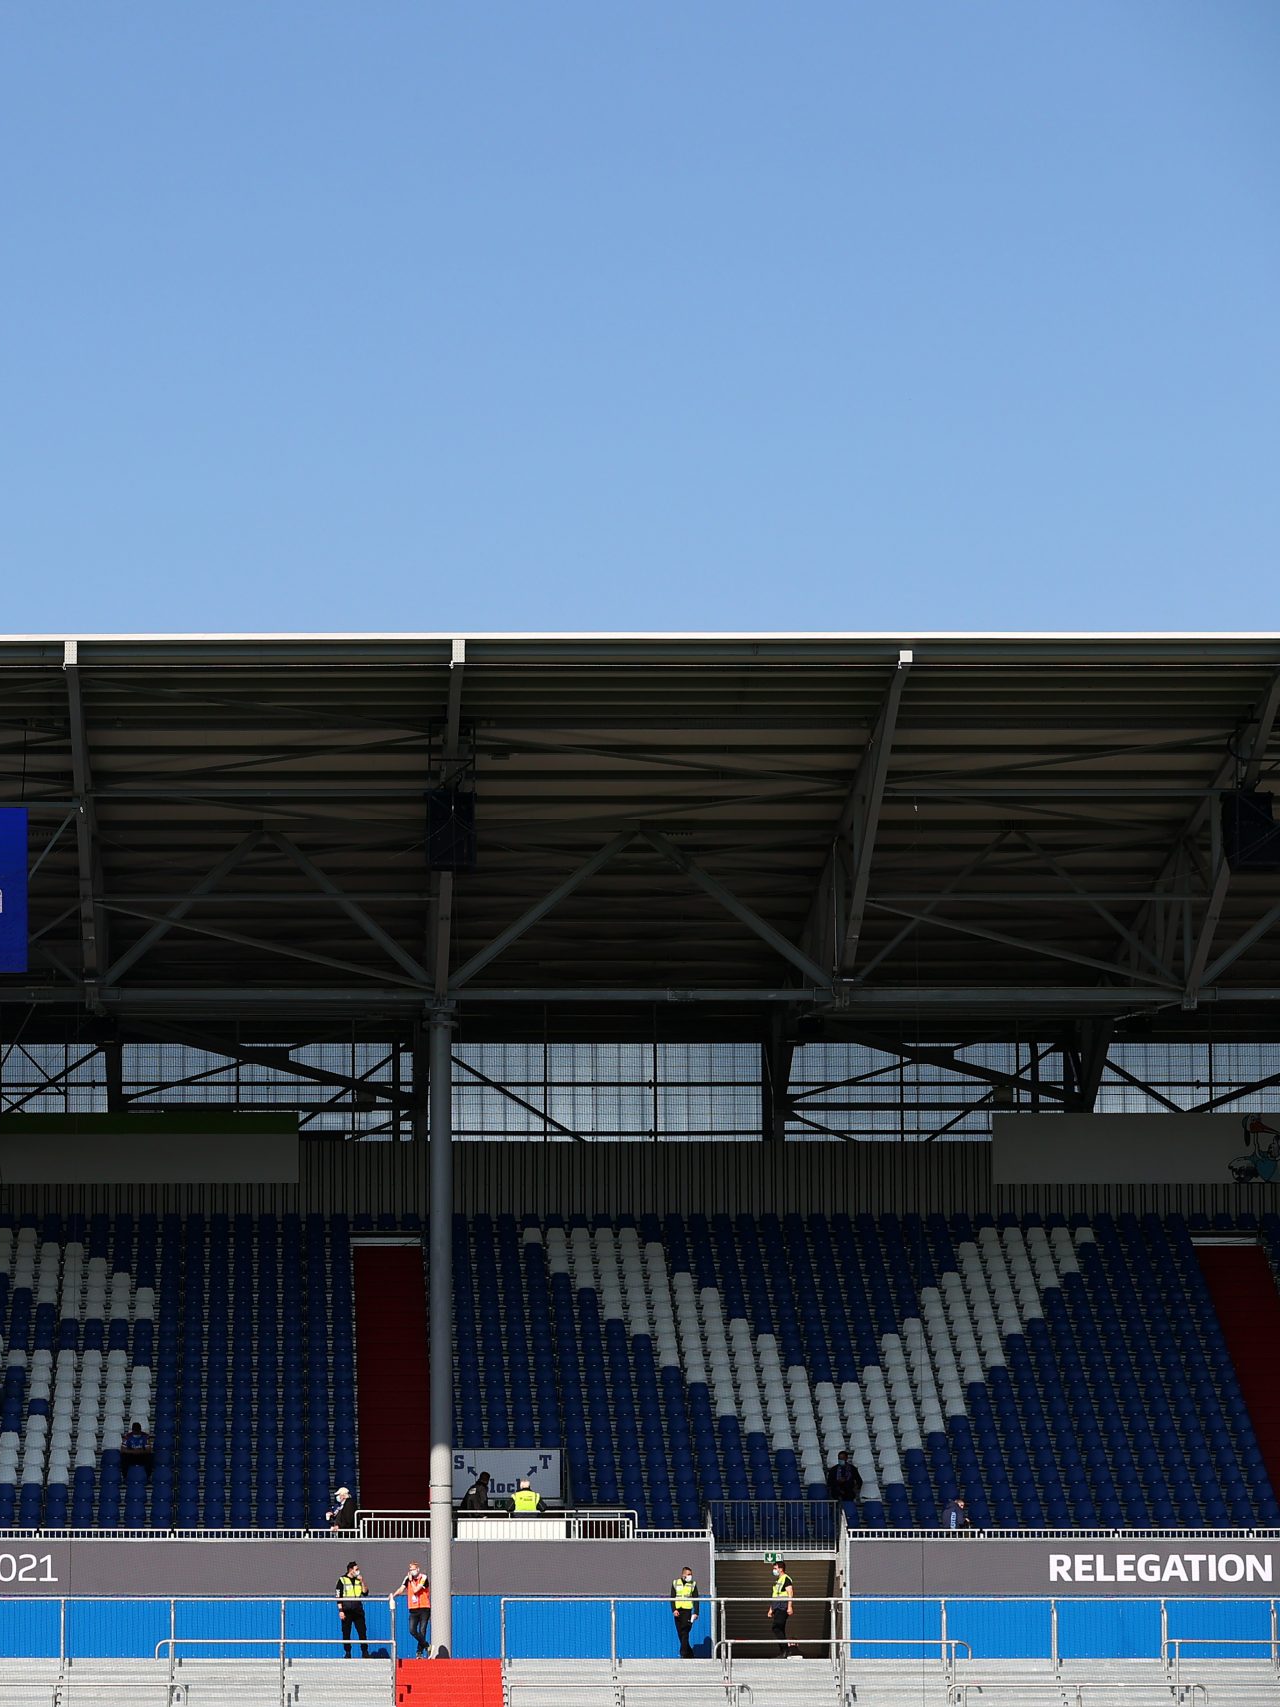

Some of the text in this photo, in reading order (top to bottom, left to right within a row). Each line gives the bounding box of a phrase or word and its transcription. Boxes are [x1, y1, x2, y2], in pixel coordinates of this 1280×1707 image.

[453, 1454, 552, 1470] S T
[1049, 1553, 1273, 1582] RELEGATION
